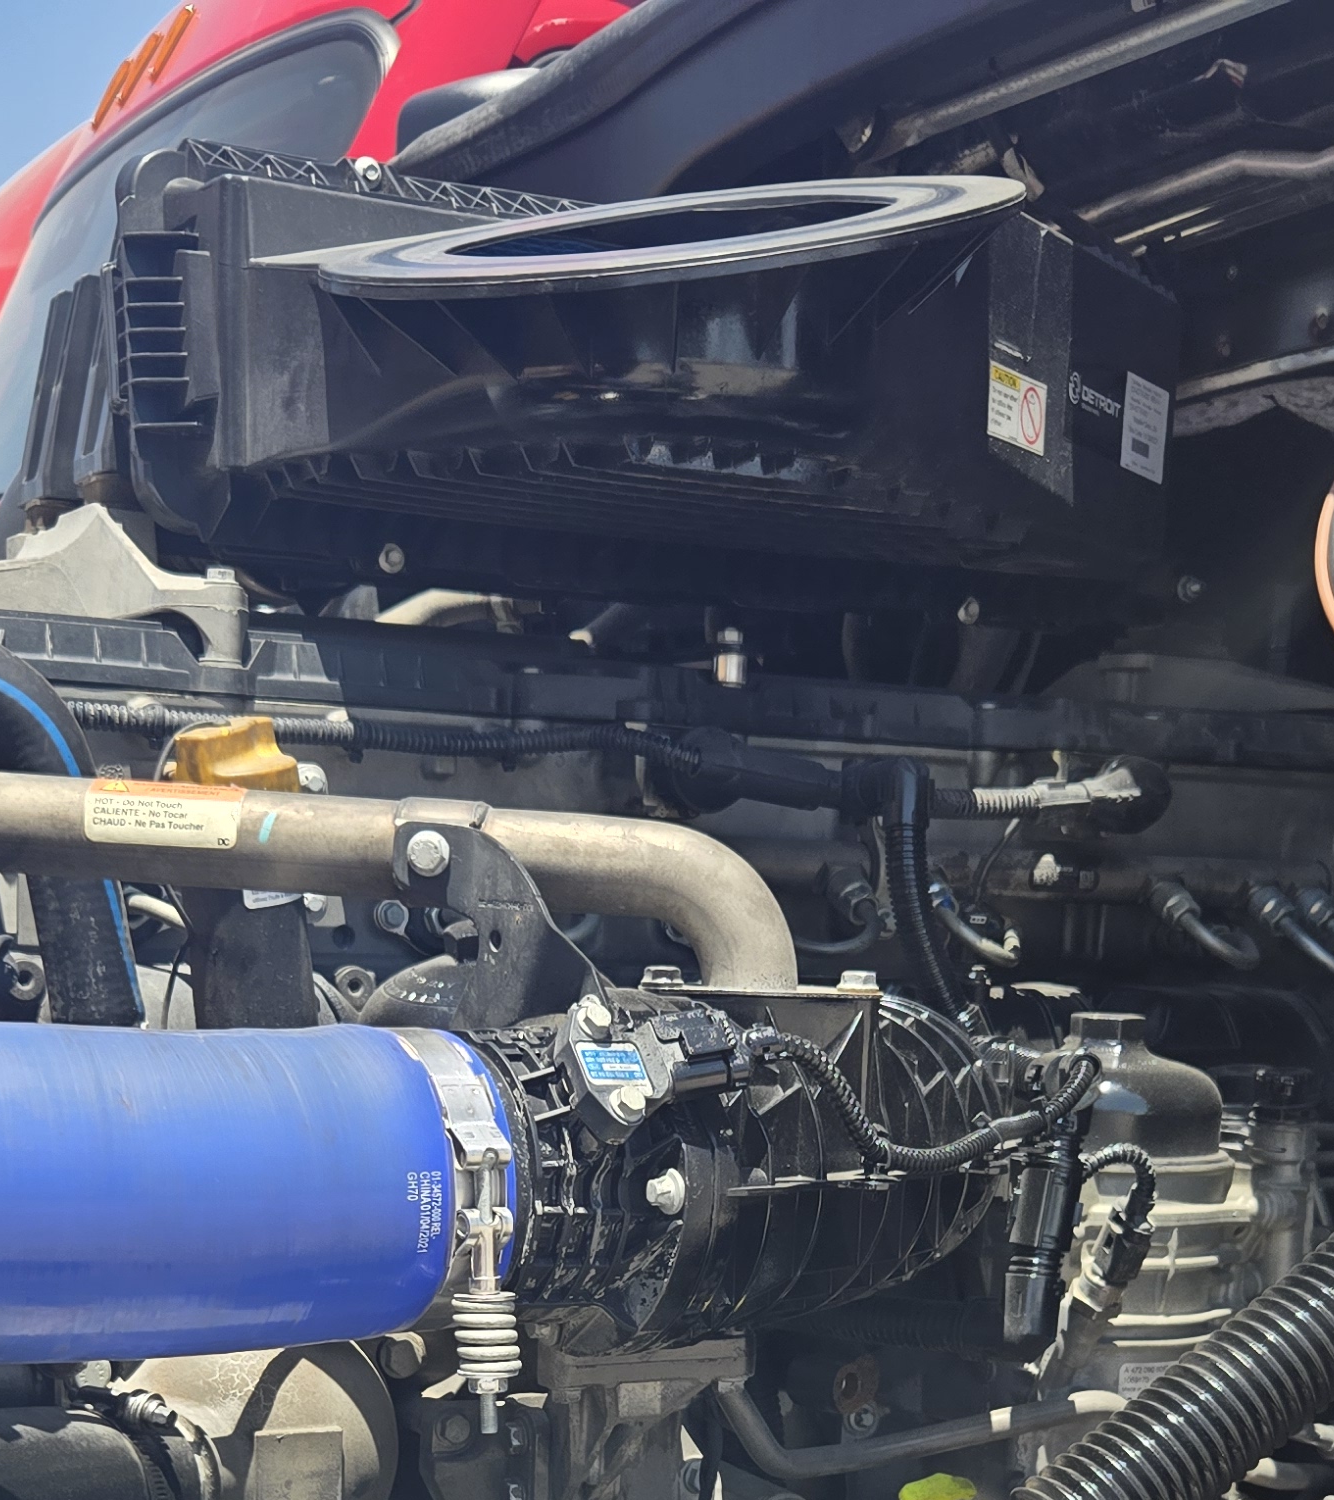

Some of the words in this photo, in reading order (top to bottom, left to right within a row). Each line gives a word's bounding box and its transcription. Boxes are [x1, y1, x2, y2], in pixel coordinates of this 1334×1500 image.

[1081, 385, 1121, 418] DETROIT
[156, 800, 183, 809] Touch
[93, 807, 140, 817] CALIENTE
[148, 810, 161, 819] No
[164, 811, 188, 820] Tocar
[92, 817, 126, 827] CHAUD
[168, 821, 205, 832] Toucher
[217, 838, 230, 847] DC
[406, 1171, 419, 1202] GH70
[419, 1171, 431, 1205] CHINA
